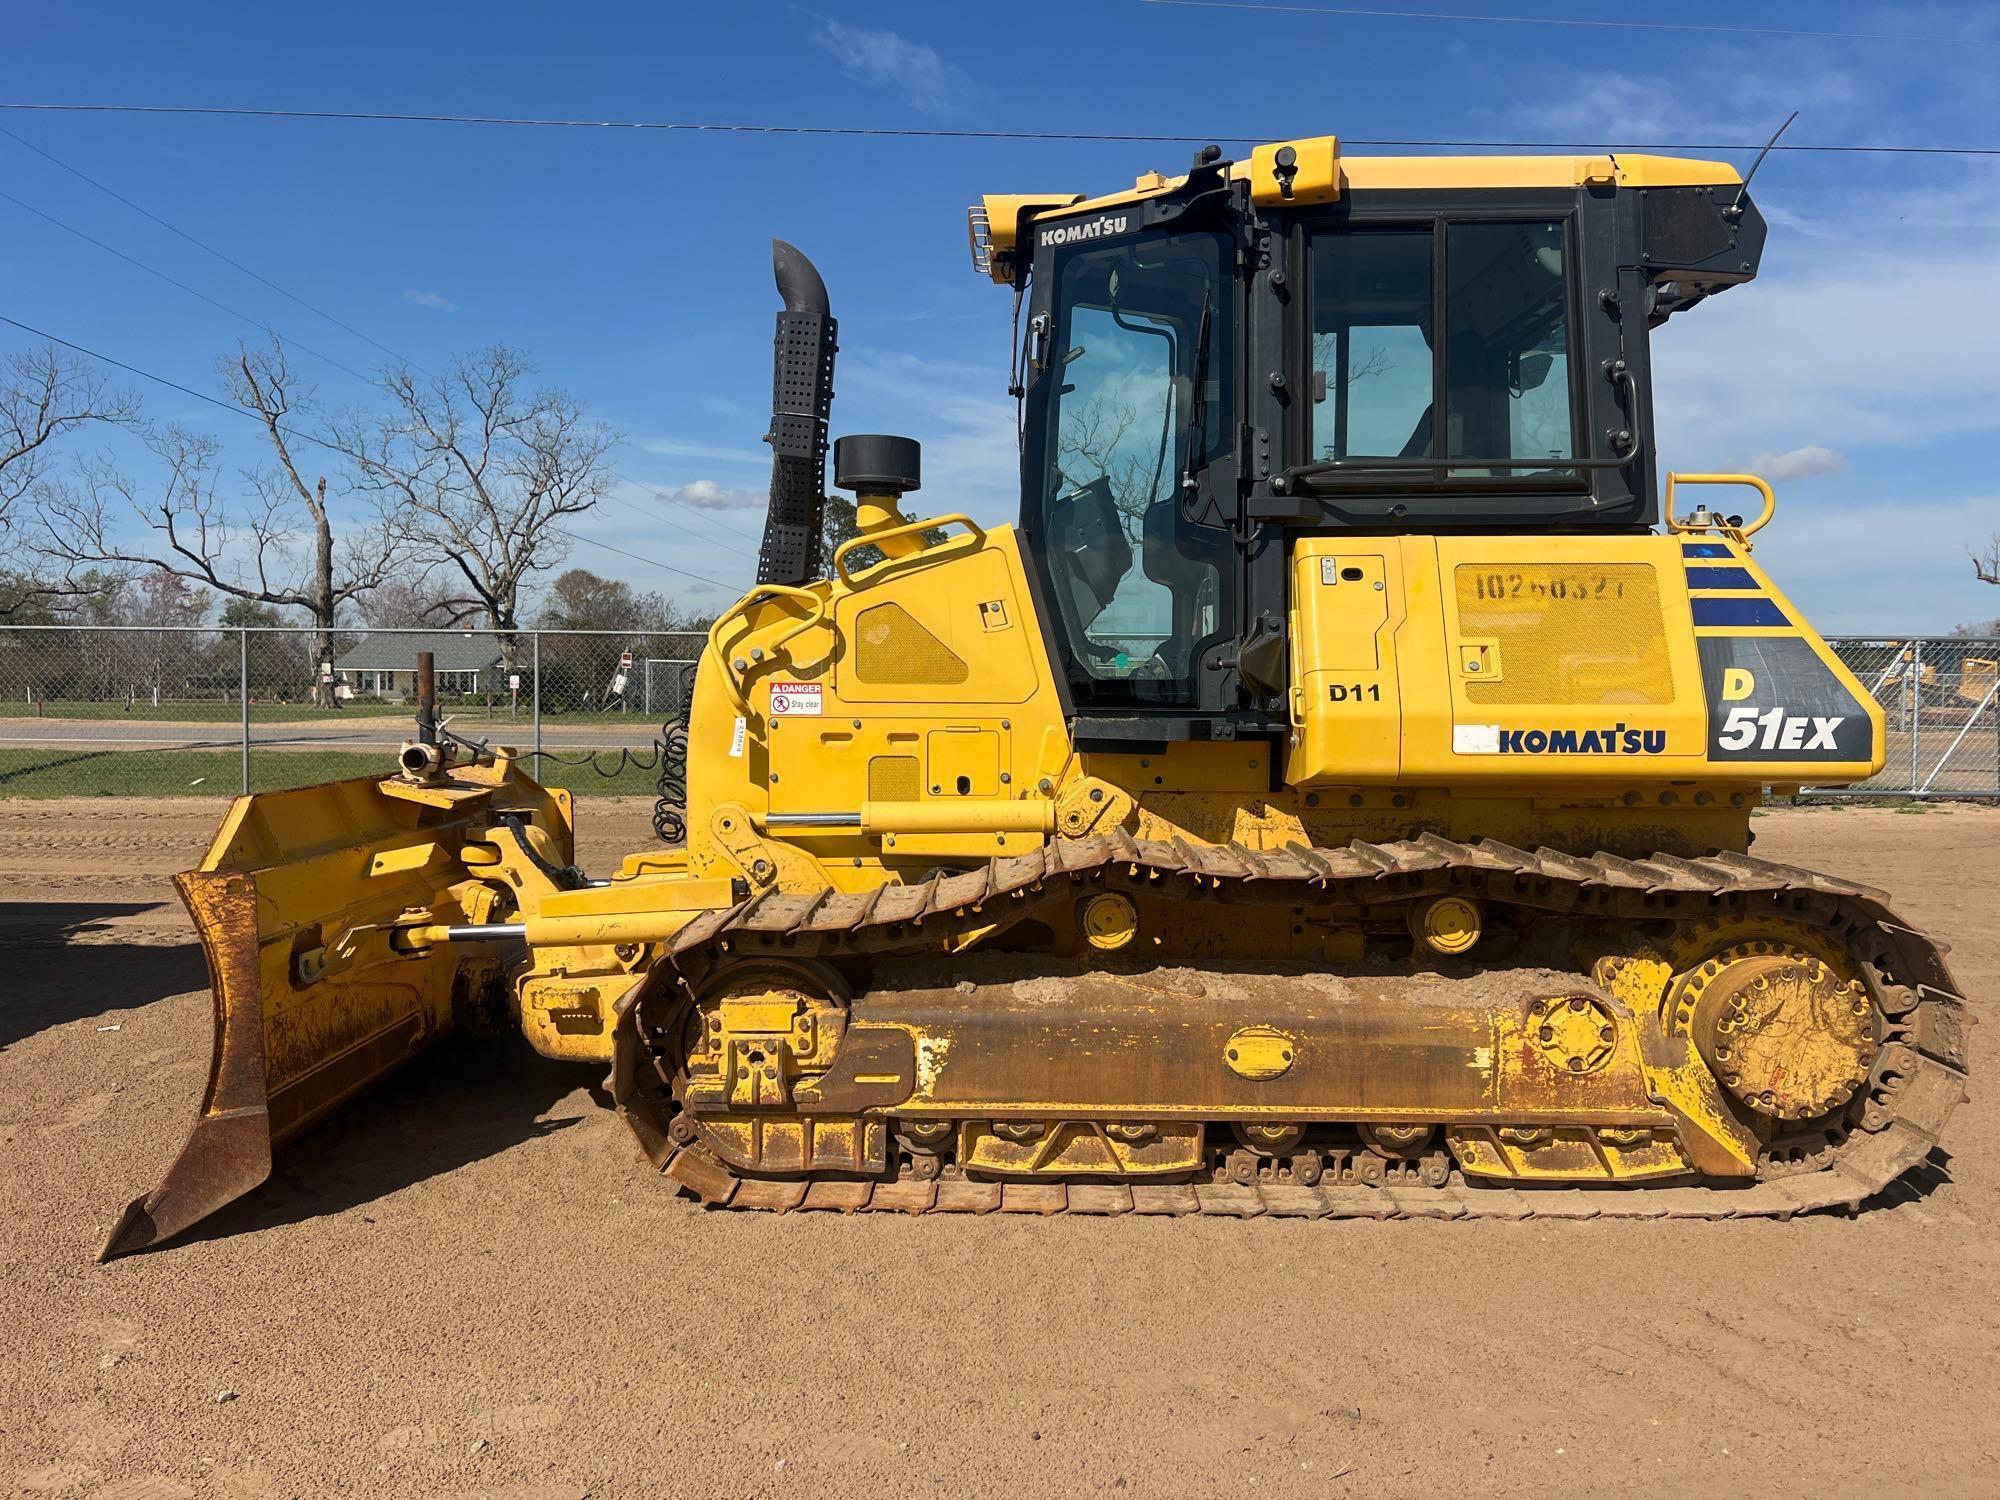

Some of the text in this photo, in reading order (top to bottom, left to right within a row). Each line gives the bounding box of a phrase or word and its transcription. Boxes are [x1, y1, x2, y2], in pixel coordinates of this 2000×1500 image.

[1041, 216, 1127, 246] KOMATSU
[781, 684, 821, 693] DANGER
[1329, 684, 1380, 701] D11
[1722, 668, 1755, 701] D
[791, 700, 819, 709] Stay clear
[1499, 723, 1666, 753] KOMATSU
[1718, 707, 1845, 751] 51EX
